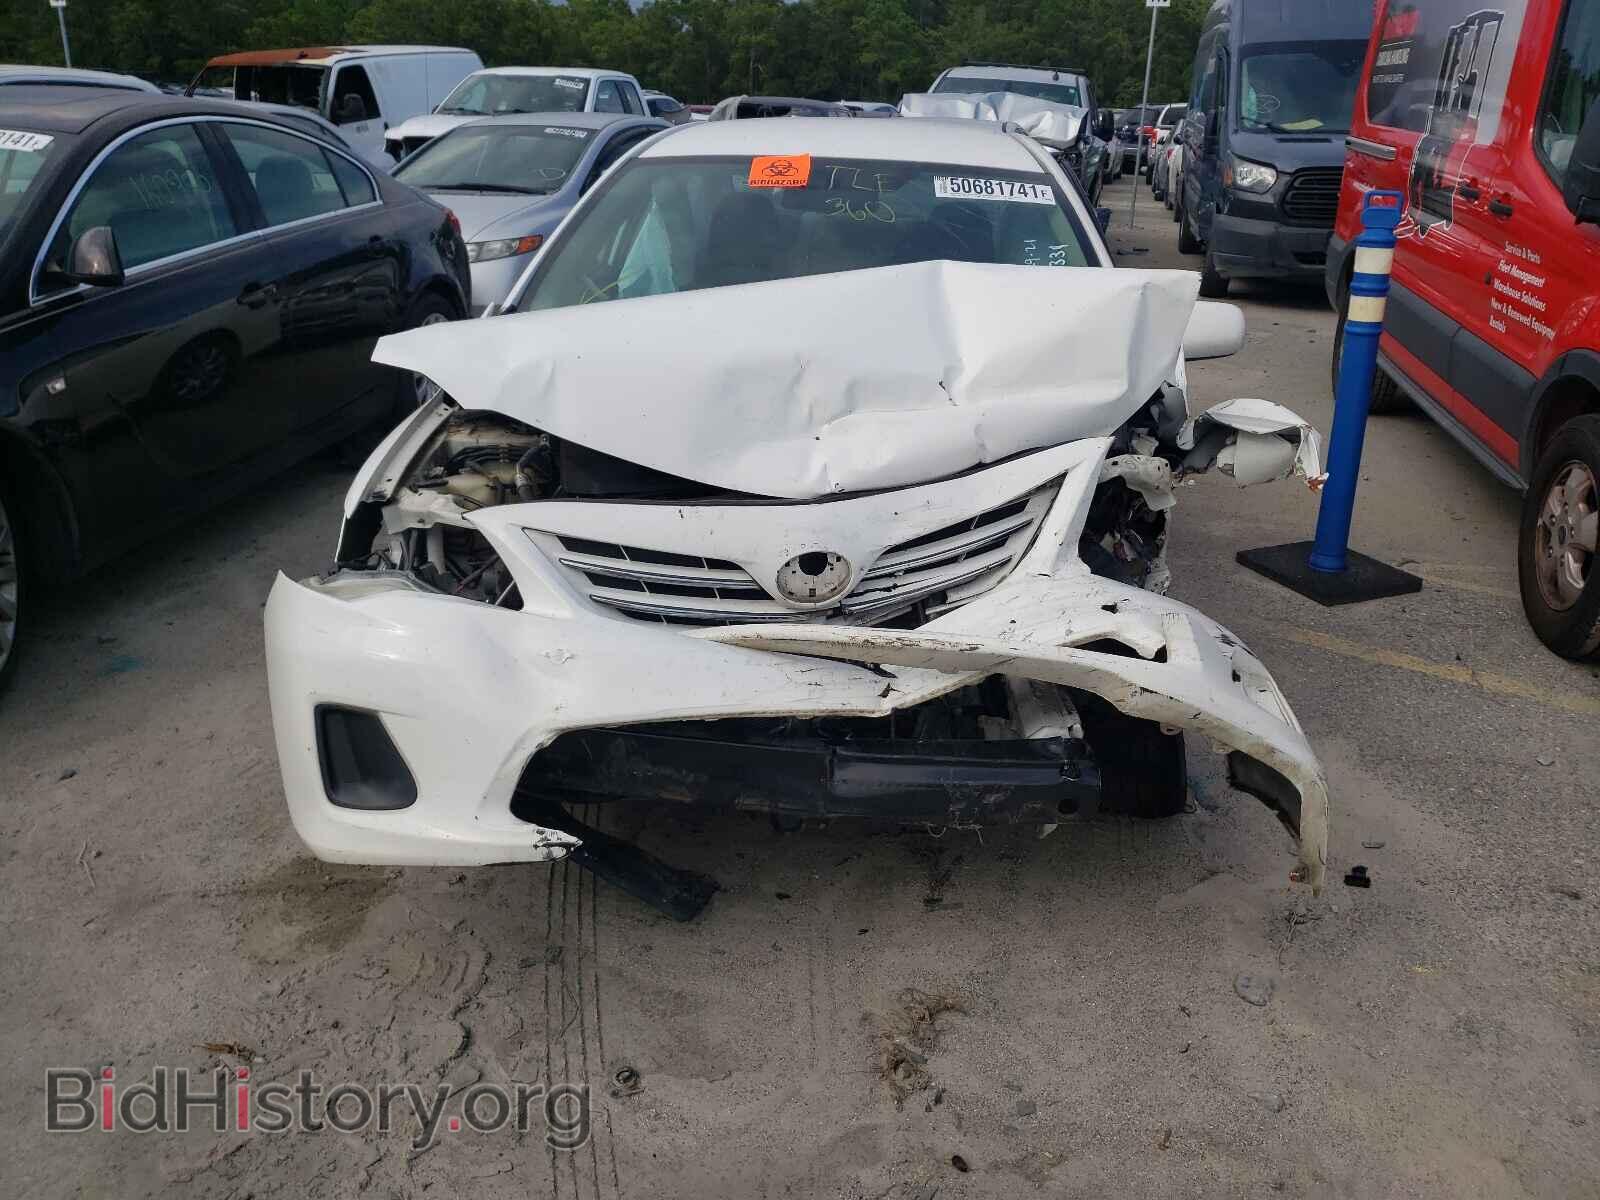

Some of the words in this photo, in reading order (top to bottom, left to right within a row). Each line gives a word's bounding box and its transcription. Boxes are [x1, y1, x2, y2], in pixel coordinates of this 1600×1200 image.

[949, 176, 1039, 199] 50681741
[1504, 241, 1521, 257] Service
[1510, 264, 1546, 288] Management
[1494, 277, 1521, 299] Warehouse
[1521, 290, 1547, 312] Solutions
[1490, 296, 1503, 310] New
[1507, 304, 1532, 326] Renewed
